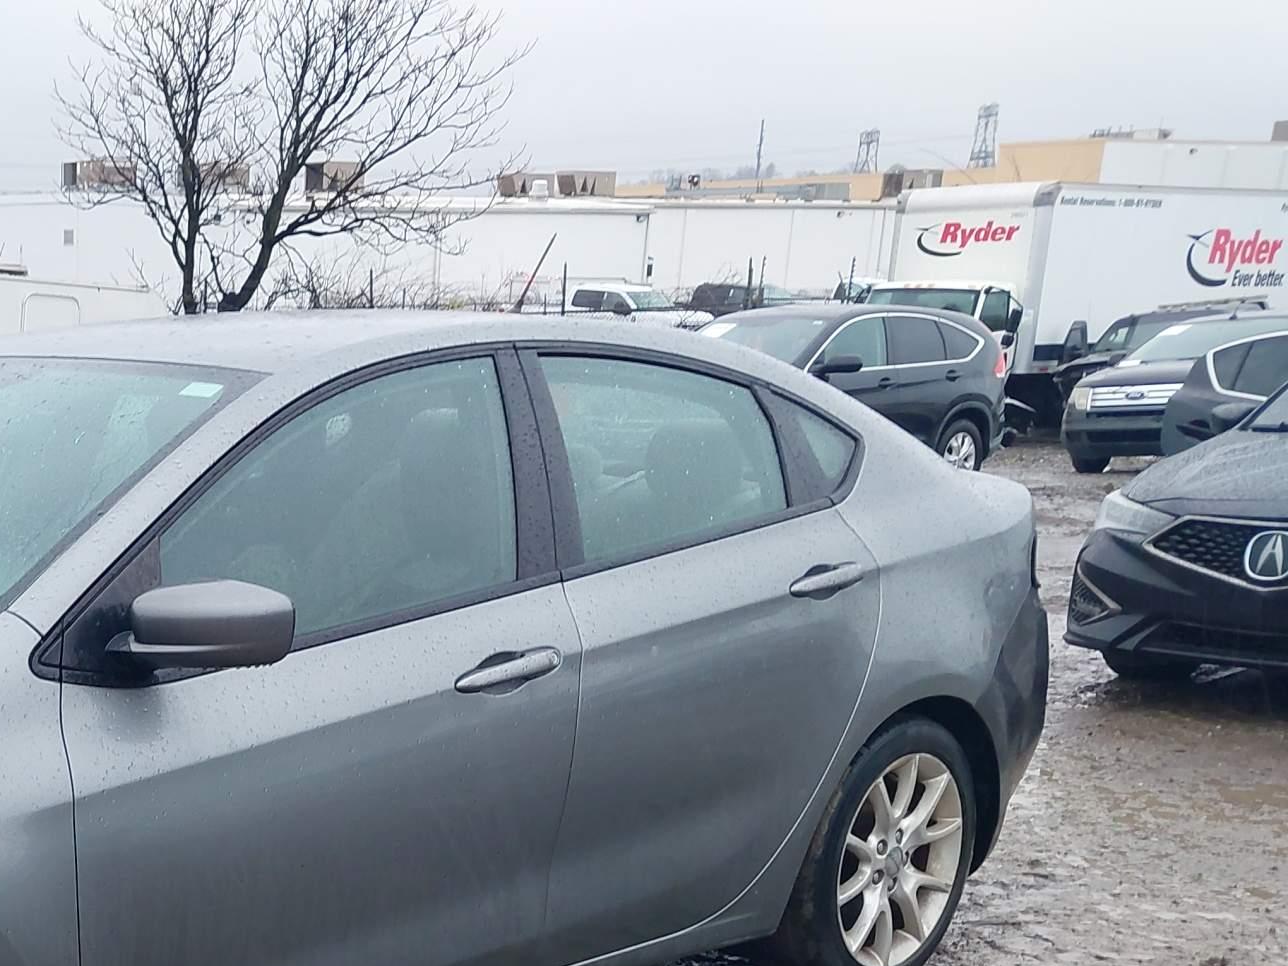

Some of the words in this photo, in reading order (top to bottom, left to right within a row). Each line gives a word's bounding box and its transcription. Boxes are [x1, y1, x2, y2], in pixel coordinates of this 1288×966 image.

[939, 221, 1020, 248] Ryder
[1208, 228, 1284, 273] Ryder
[1231, 269, 1255, 287] Ever
